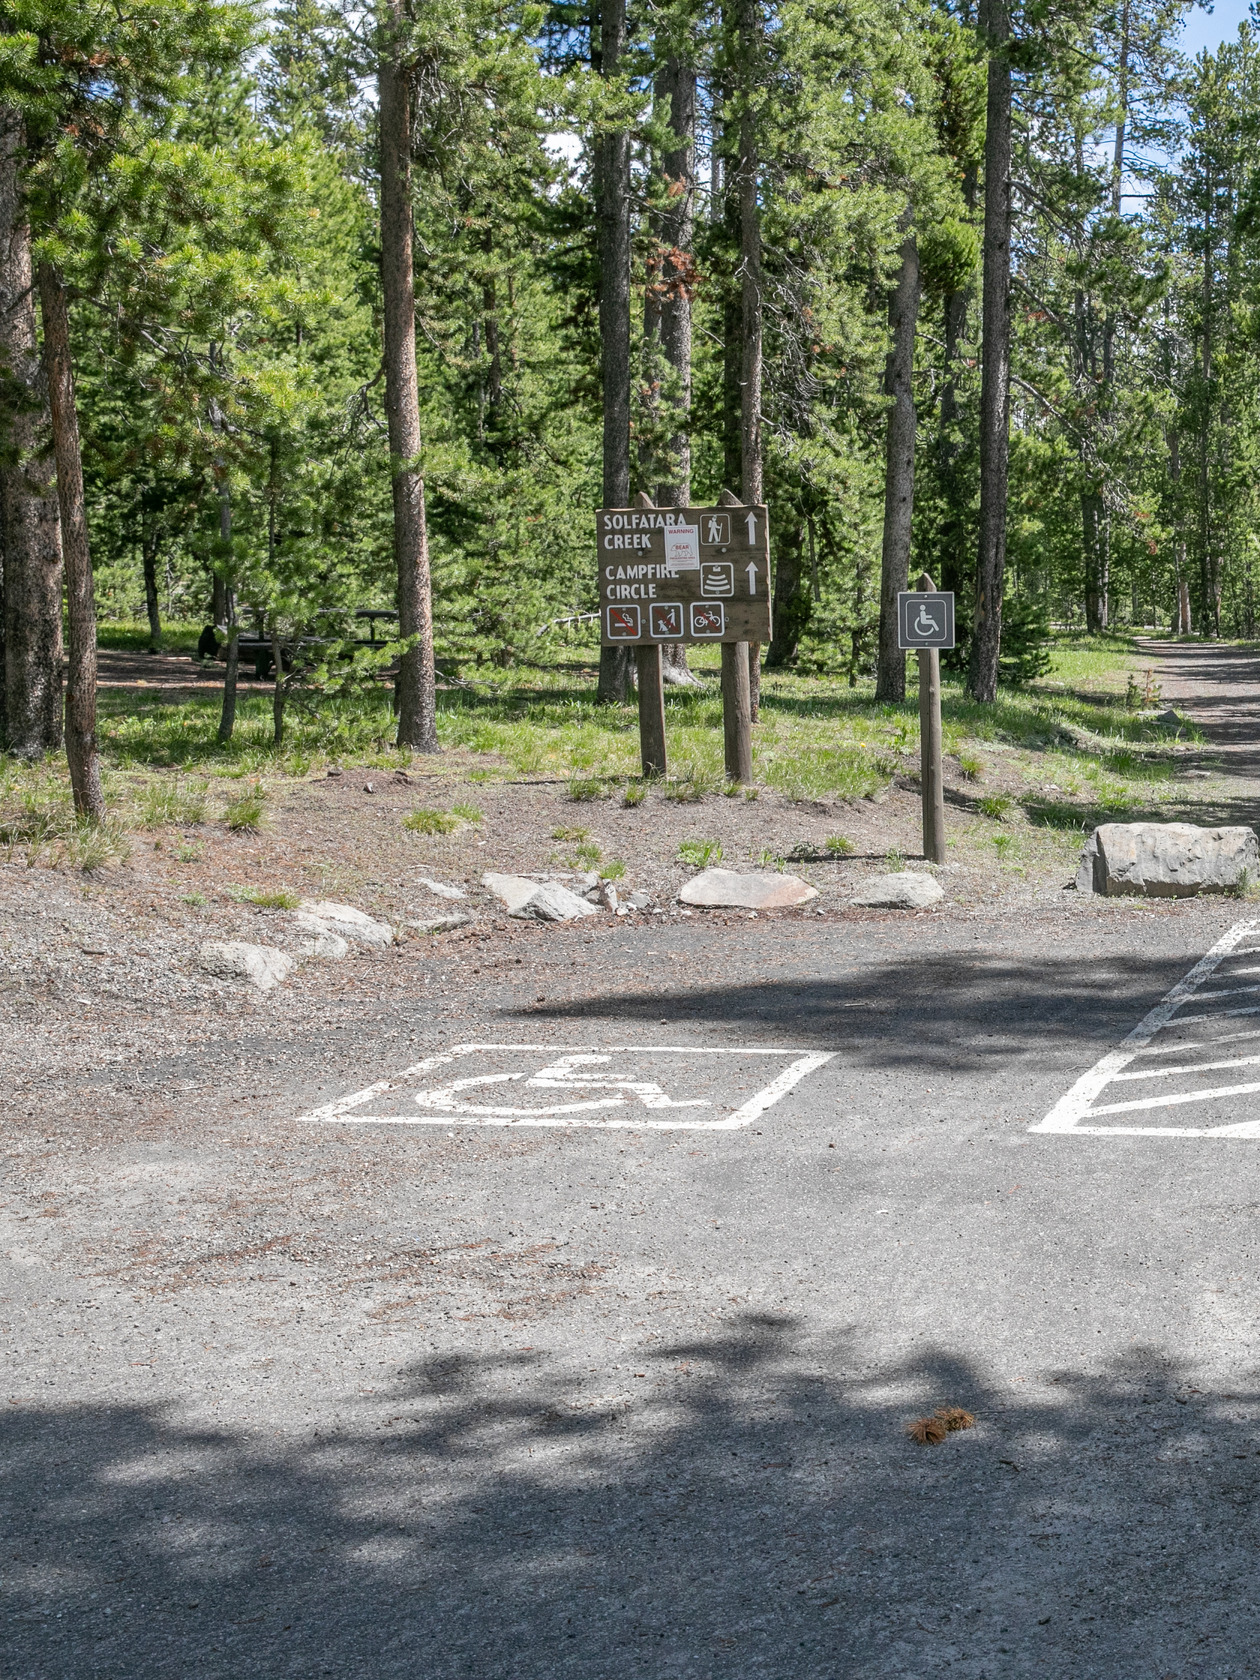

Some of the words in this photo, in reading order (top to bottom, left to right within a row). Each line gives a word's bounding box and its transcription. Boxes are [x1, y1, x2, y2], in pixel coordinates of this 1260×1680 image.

[603, 513, 687, 530] SOLFATARA
[604, 533, 652, 550] CREEK
[605, 564, 680, 580] CAMPFIRE
[606, 583, 657, 600] CIRCLE
